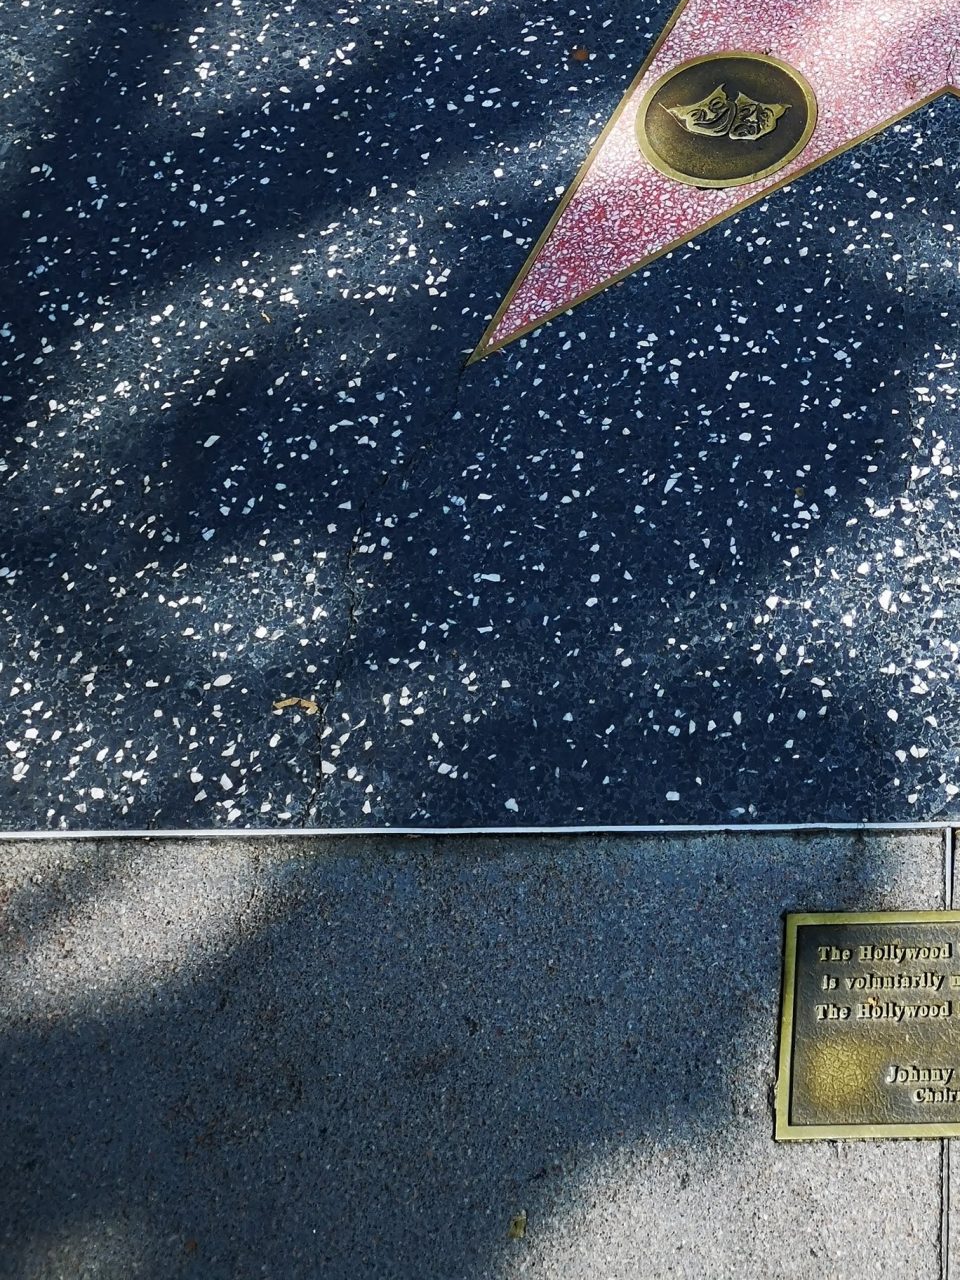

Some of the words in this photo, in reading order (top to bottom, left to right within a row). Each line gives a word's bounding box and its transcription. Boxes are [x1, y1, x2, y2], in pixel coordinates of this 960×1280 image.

[818, 946, 850, 961] The
[858, 942, 950, 962] Hollywood
[822, 974, 837, 990] is
[845, 972, 943, 992] voluntarily
[815, 1004, 849, 1020] The
[856, 999, 950, 1021] Hollywood
[886, 1065, 954, 1085] Johnny
